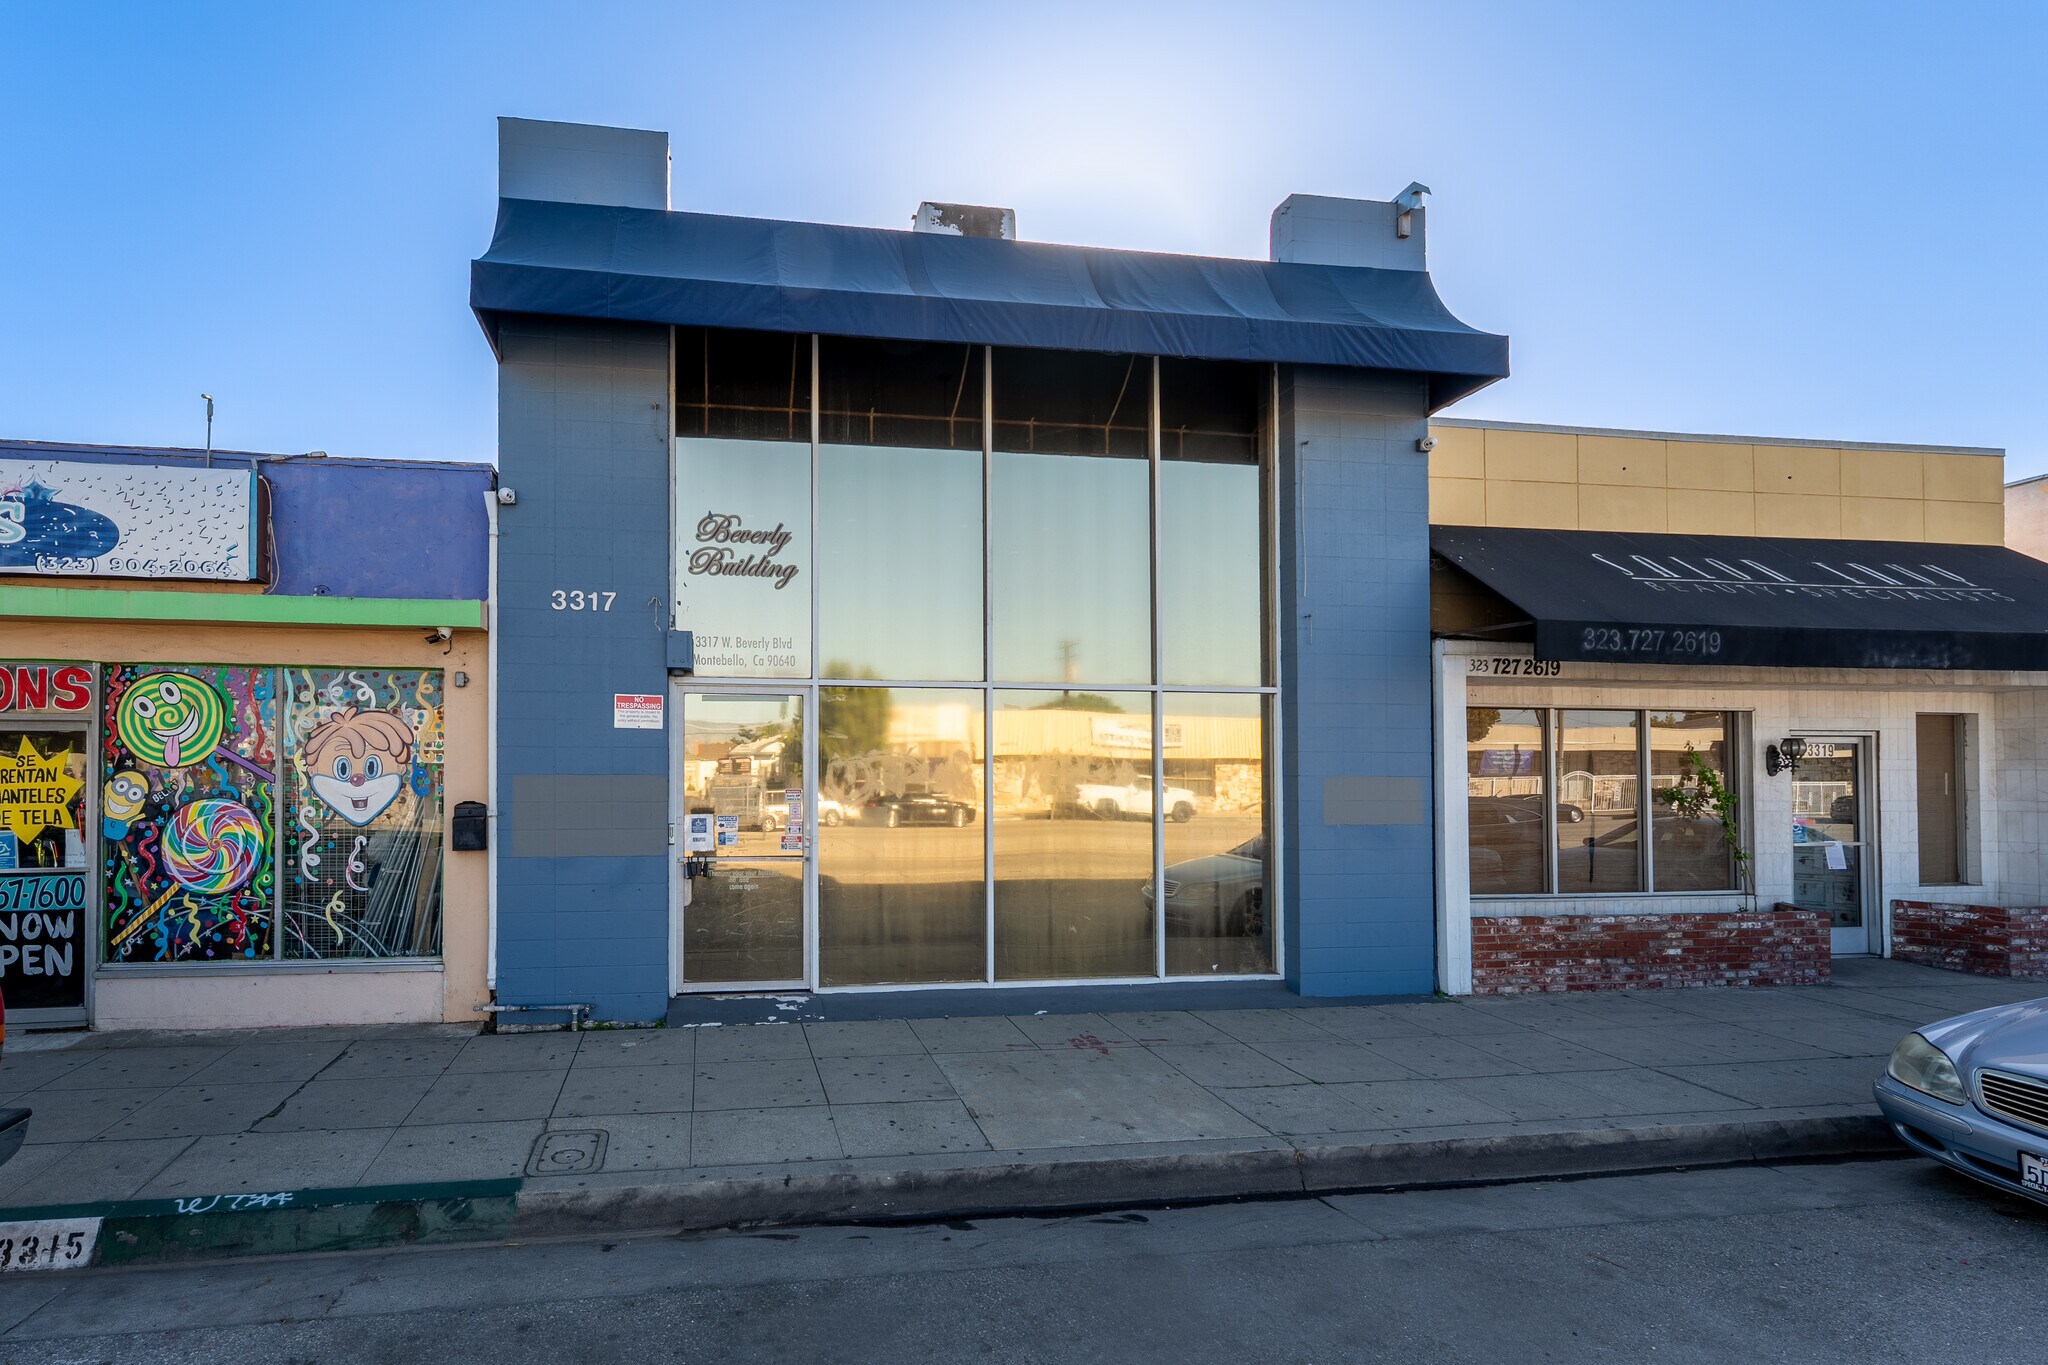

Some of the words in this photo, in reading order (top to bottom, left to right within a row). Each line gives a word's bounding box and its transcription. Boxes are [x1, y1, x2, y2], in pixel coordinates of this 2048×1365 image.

[695, 513, 792, 556] Beverly
[34, 556, 99, 573] (323)
[688, 546, 799, 590] Building
[1643, 581, 1777, 596] BEAUTY
[1800, 586, 2016, 602] SPECIALISTS
[550, 590, 617, 611] 3317
[695, 636, 719, 648] 3317
[721, 636, 733, 648] W.
[735, 636, 770, 651] Beverly
[772, 637, 793, 649] Blvd
[1672, 630, 1722, 654] 2619
[693, 654, 747, 667] Montebello,
[753, 655, 765, 666] Ca
[767, 655, 796, 667] 90640
[1469, 658, 1489, 672] 323
[1492, 657, 1521, 675] 727
[1523, 658, 1561, 676] 2619
[616, 702, 661, 710] TRESPASSING
[1807, 744, 1834, 757] 3319
[16, 755, 36, 767] SE
[0, 767, 58, 784] RENTAN
[0, 788, 66, 804] ANTELES
[19, 809, 62, 825] TELA
[0, 910, 74, 940] NOW
